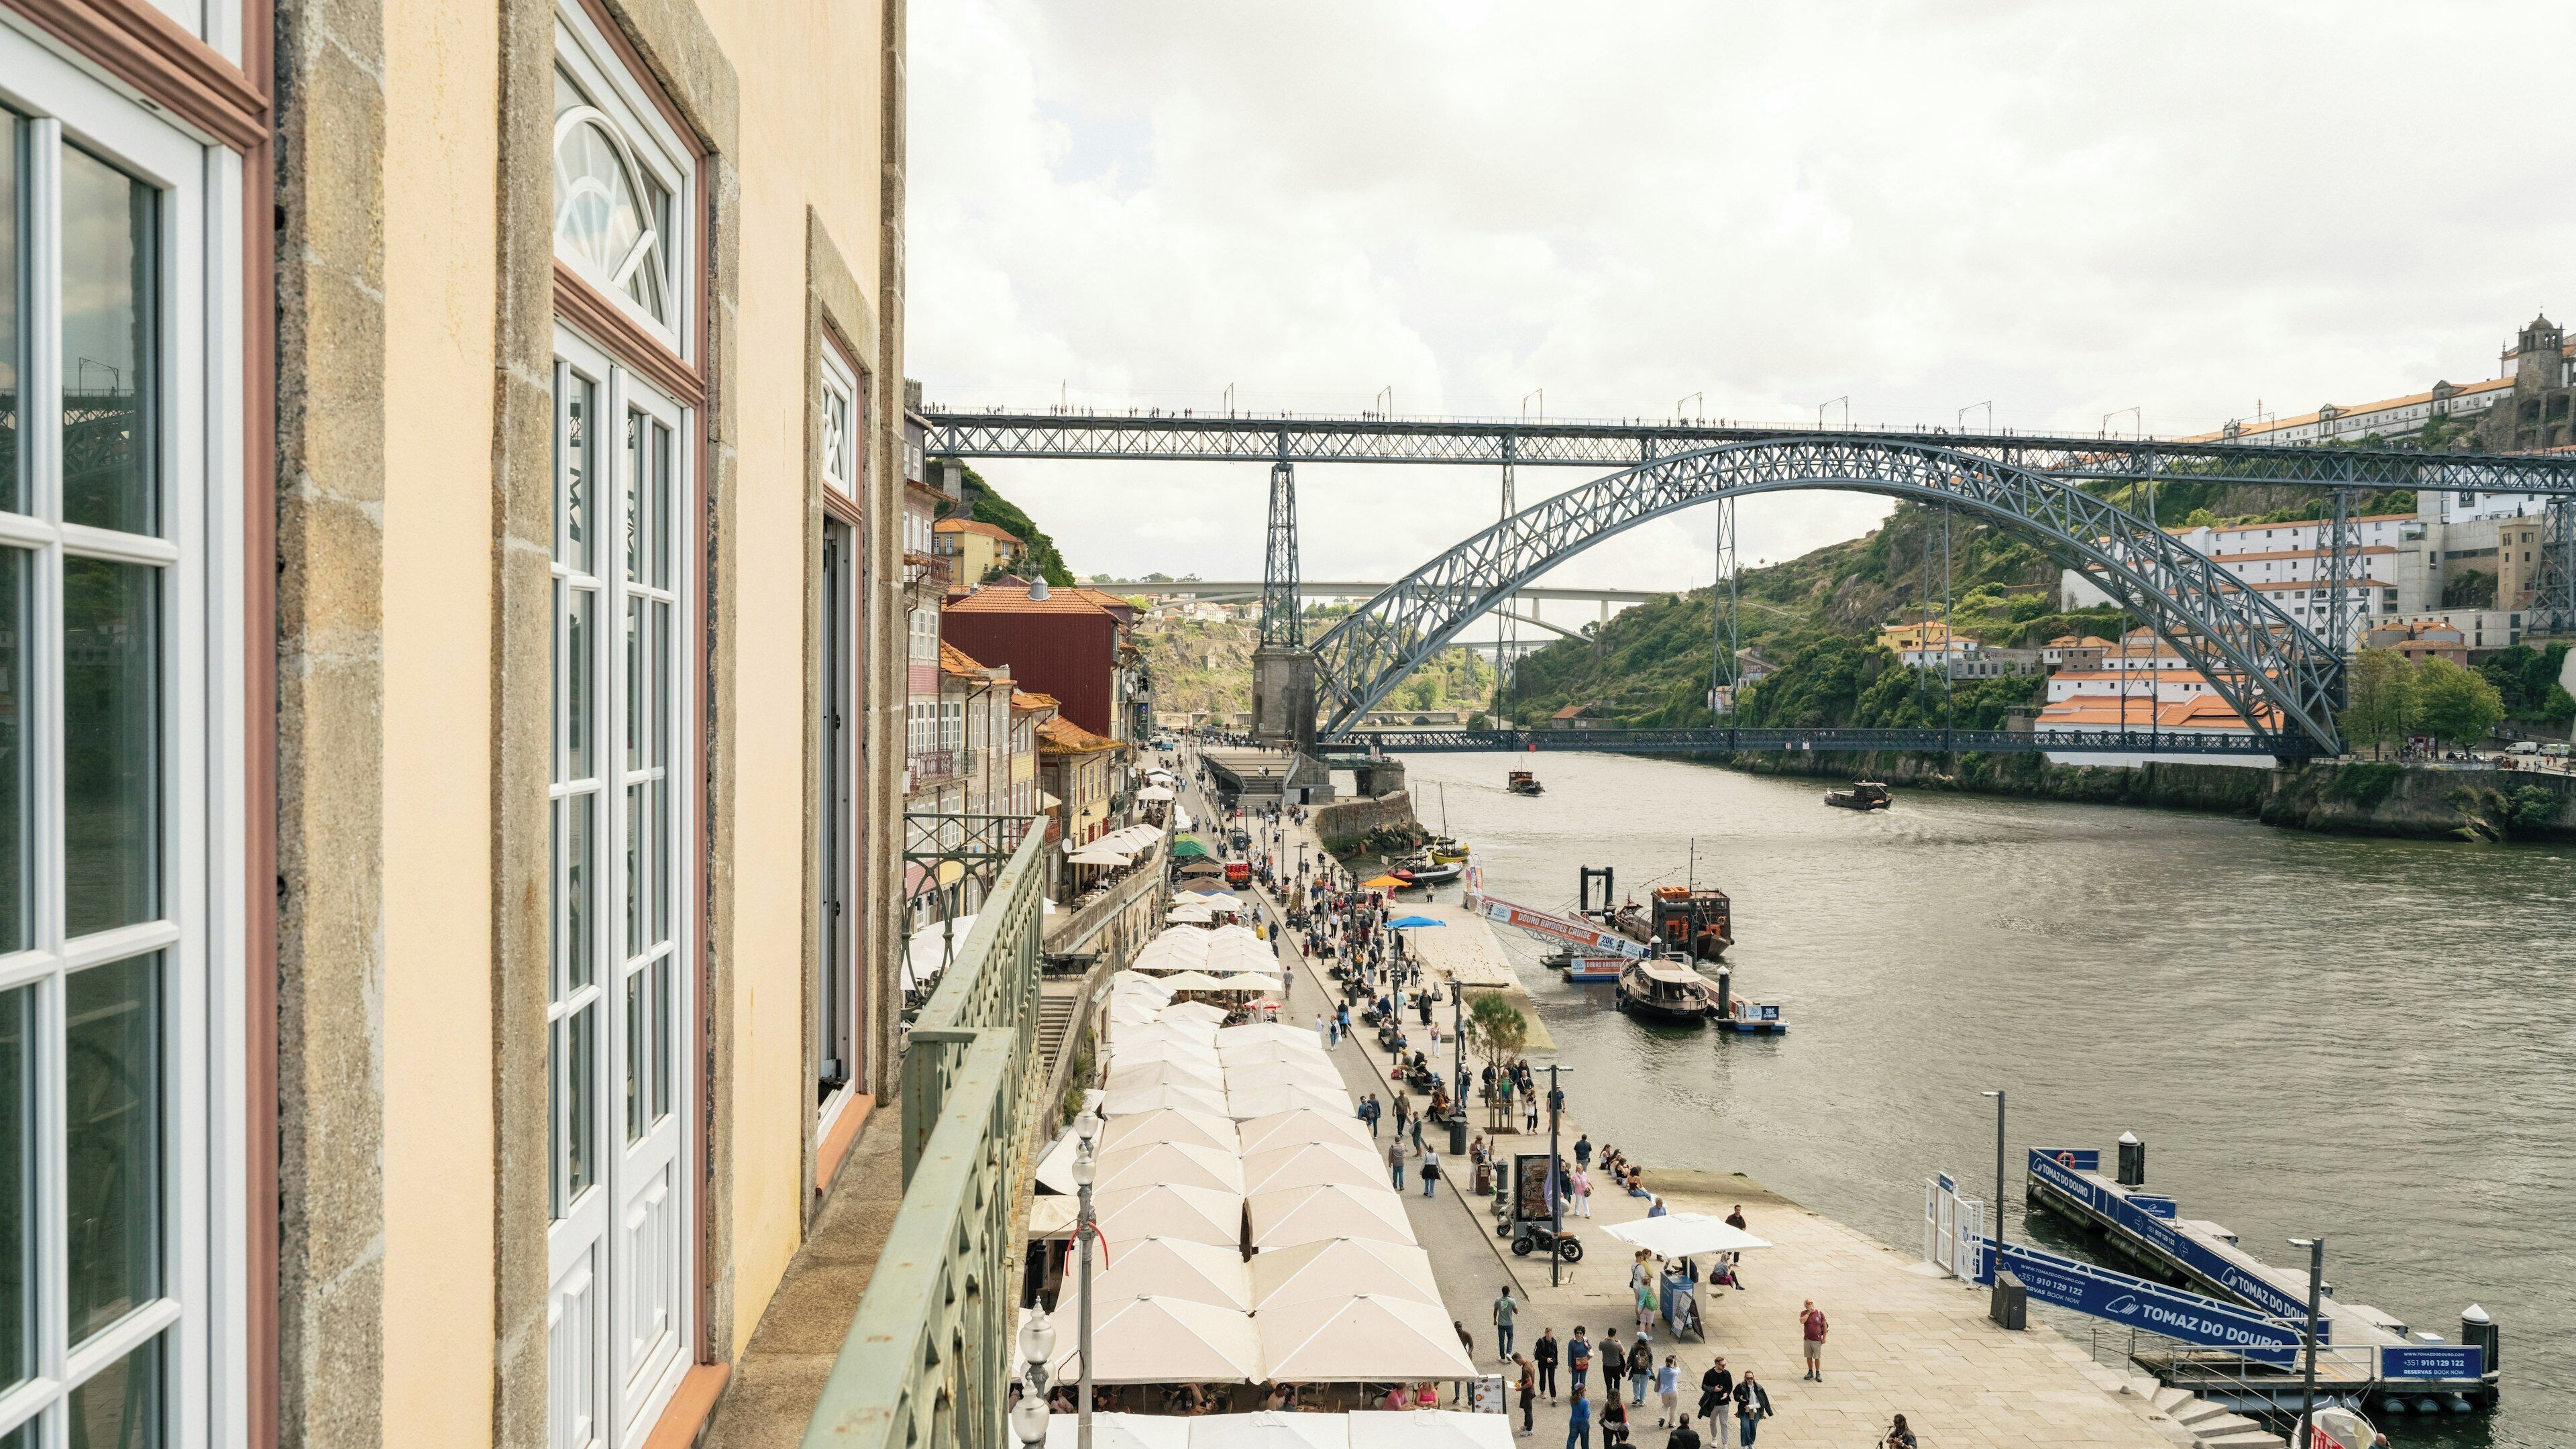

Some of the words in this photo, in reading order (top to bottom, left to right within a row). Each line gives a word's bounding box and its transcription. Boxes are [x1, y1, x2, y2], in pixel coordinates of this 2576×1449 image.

[1517, 913, 1540, 926] DOURO
[1540, 919, 1568, 933] BRIDGES
[1568, 926, 1592, 940] CRUISE
[1602, 936, 1613, 945] 20€
[2042, 1163, 2061, 1182] TOMAZ
[2060, 1175, 2068, 1186] DO
[2069, 1178, 2088, 1197] DOURO
[2018, 1273, 2035, 1283] +351
[2036, 1277, 2051, 1287] 910
[2053, 1281, 2067, 1291] 129
[2069, 1286, 2083, 1296] 122
[2021, 1264, 2086, 1286] WWW.TOMAZDODOURO.COM
[2026, 1285, 2045, 1295] ERVAS
[2047, 1291, 2064, 1300] BOOK
[2065, 1296, 2080, 1305] NOW
[2238, 1276, 2269, 1305] TOMAZ
[2269, 1294, 2283, 1313] DO
[2284, 1302, 2308, 1328] DOUR
[2143, 1304, 2199, 1331] TOMAZ
[2200, 1320, 2224, 1337] DO
[2225, 1326, 2283, 1353] DOURO
